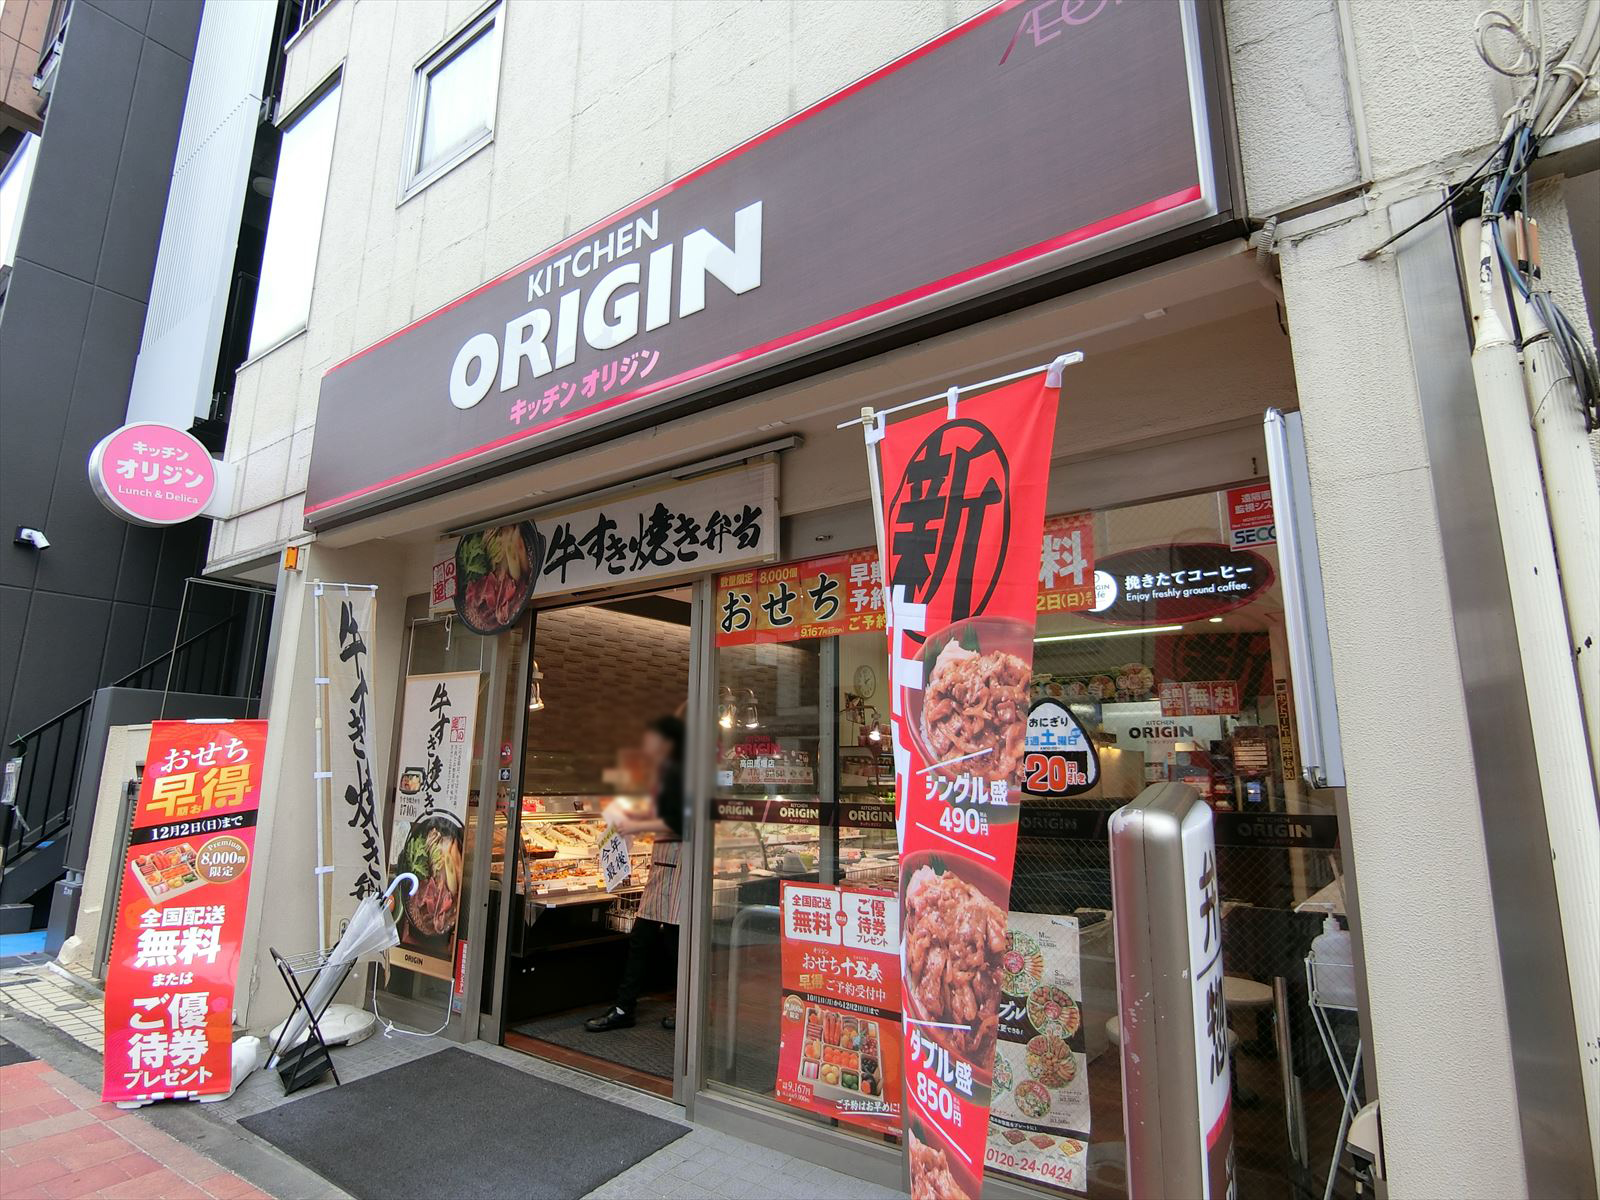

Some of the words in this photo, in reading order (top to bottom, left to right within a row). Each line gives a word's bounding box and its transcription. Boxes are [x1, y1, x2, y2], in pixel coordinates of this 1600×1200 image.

[527, 209, 659, 302] KITCHEN
[449, 200, 763, 410] ORIGIN
[510, 381, 577, 424] キッチン
[581, 350, 660, 398] オリジン
[132, 441, 190, 461] キッチン
[116, 459, 204, 488] オリジン
[118, 484, 152, 497] Lunch
[154, 490, 163, 499] &
[165, 491, 199, 504] Delica
[544, 502, 762, 584] 牛すき焼き弁当
[760, 567, 797, 584] 8,000個
[1124, 565, 1253, 590] 挽きたてコーヒー
[721, 573, 839, 633] おせち
[1126, 592, 1150, 602] Enjoy
[1152, 589, 1181, 600] freshly
[1183, 585, 1215, 597] ground
[1217, 581, 1250, 592] coffee.
[1029, 716, 1068, 727] おにぎり
[1129, 726, 1194, 739] ORIGIN
[161, 738, 249, 773] おせち
[421, 683, 452, 815] 牛すき焼き
[926, 773, 1008, 806] シングル盛
[718, 805, 754, 816] ORIGIN
[779, 807, 819, 819] ORIGIN
[848, 811, 893, 823] ORIGIN
[152, 815, 244, 841] 12月2日(日)まで
[1239, 822, 1313, 838] ORIGIN
[207, 840, 242, 851] Premium
[200, 851, 246, 865] 8,000個
[209, 866, 234, 877] 限定
[792, 894, 832, 910] 全国配送
[140, 905, 225, 928] 全国配送
[792, 909, 832, 937] 無料
[134, 926, 221, 968] 無料
[856, 935, 889, 948] プレゼント
[404, 954, 424, 966] ORIGIN
[152, 972, 193, 986] または
[826, 979, 886, 1003] ご予約受付中
[129, 992, 209, 1029] ご優
[128, 1029, 208, 1069] 待券
[911, 1029, 972, 1096] ダブル盛
[124, 1066, 213, 1089] プレゼント
[835, 1099, 900, 1113] ご予約はお早めに!
[986, 1149, 1073, 1183] 0120-24-0424
